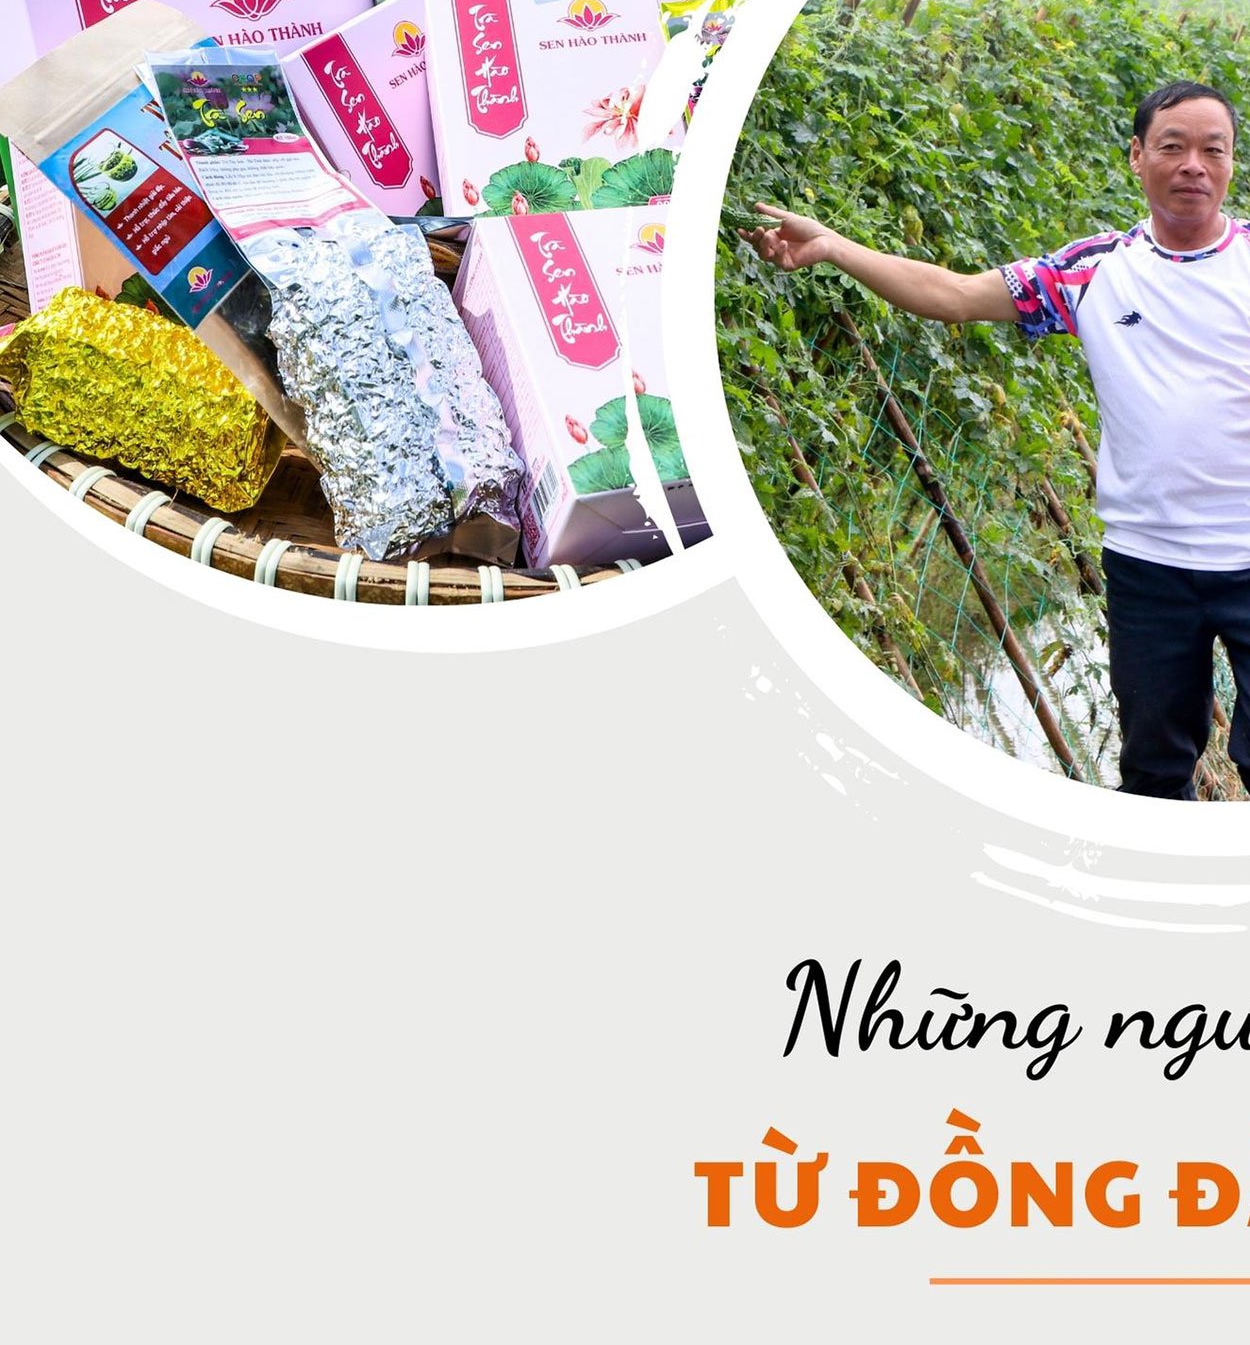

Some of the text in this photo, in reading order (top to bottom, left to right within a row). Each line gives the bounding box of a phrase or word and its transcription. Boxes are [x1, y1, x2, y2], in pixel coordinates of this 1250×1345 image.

[228, 27, 264, 46] HÀO
[267, 21, 324, 42] THÀNH
[471, 32, 503, 55] Sen
[539, 32, 647, 51] SEN HÀO THÀNH
[389, 72, 408, 89] SEN
[235, 99, 266, 124] Sen
[339, 88, 366, 113] Sen
[541, 259, 576, 283] Sen
